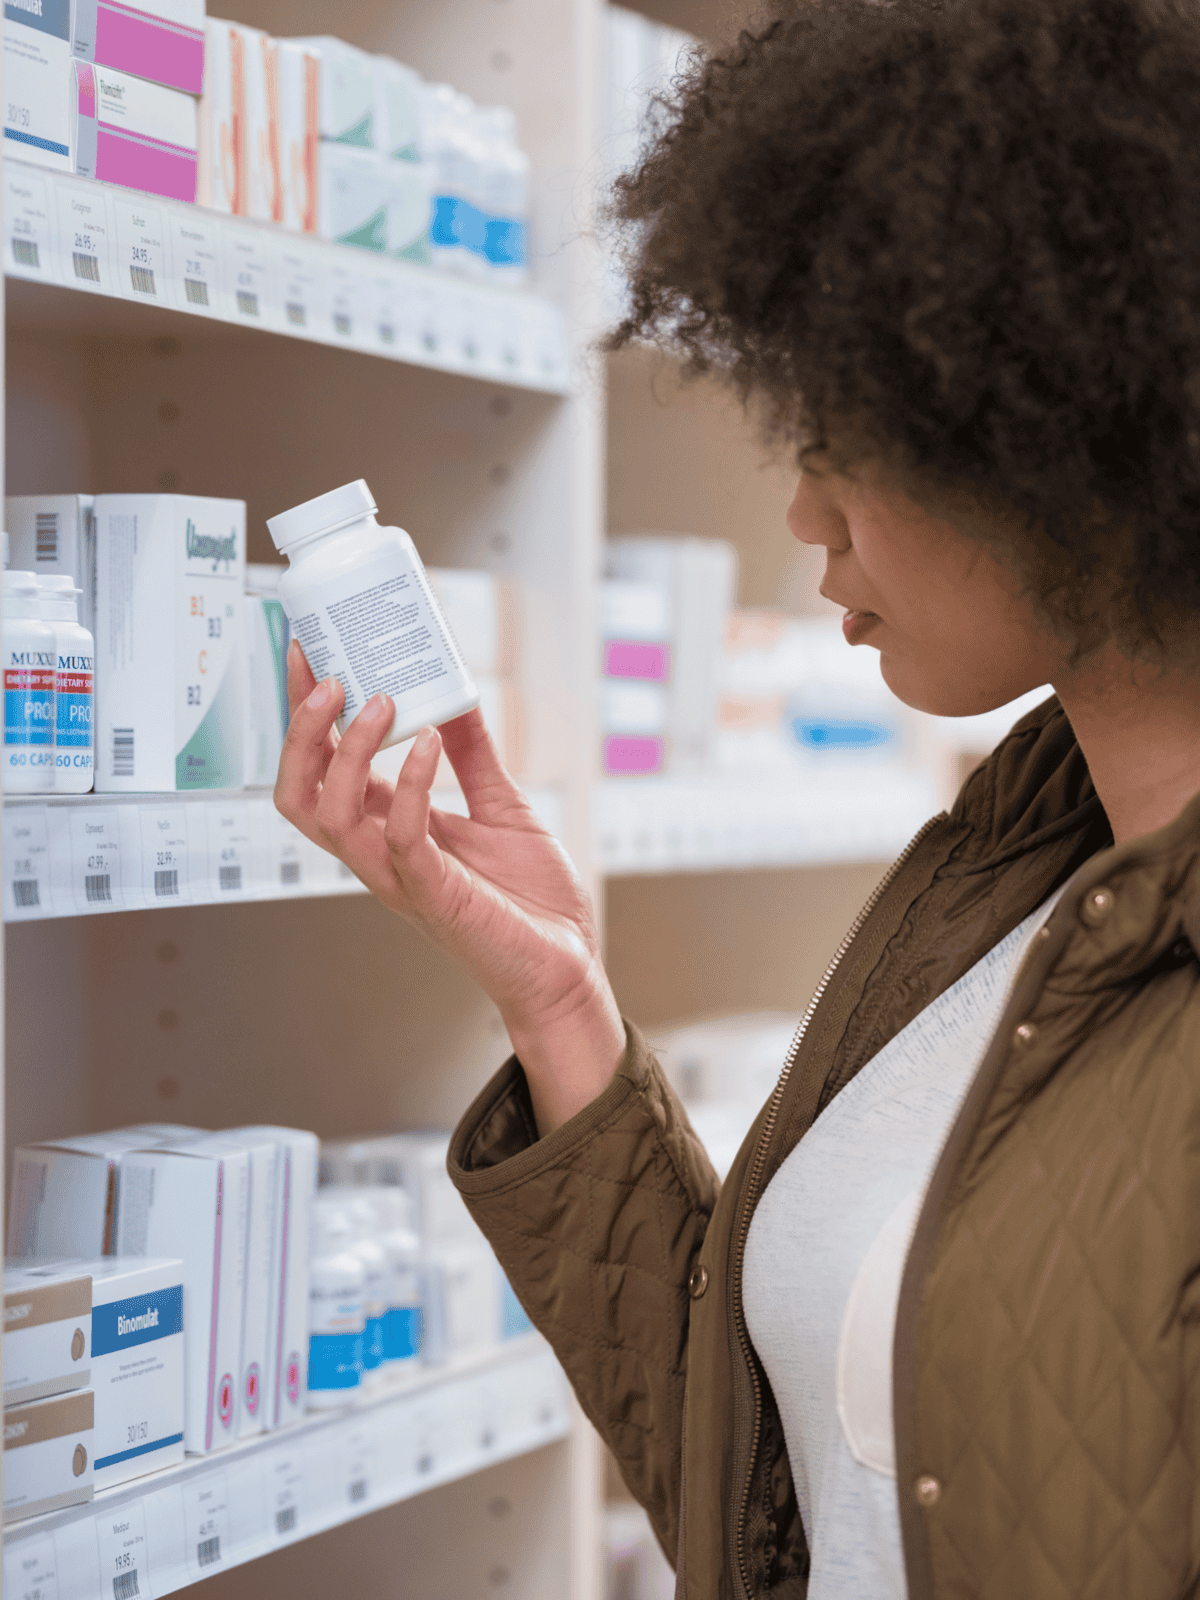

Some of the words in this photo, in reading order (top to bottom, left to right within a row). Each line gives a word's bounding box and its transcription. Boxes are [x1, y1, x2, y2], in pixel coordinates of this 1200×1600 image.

[10, 753, 27, 767] 60
[56, 755, 71, 768] 60
[118, 1307, 160, 1336] Binomulat
